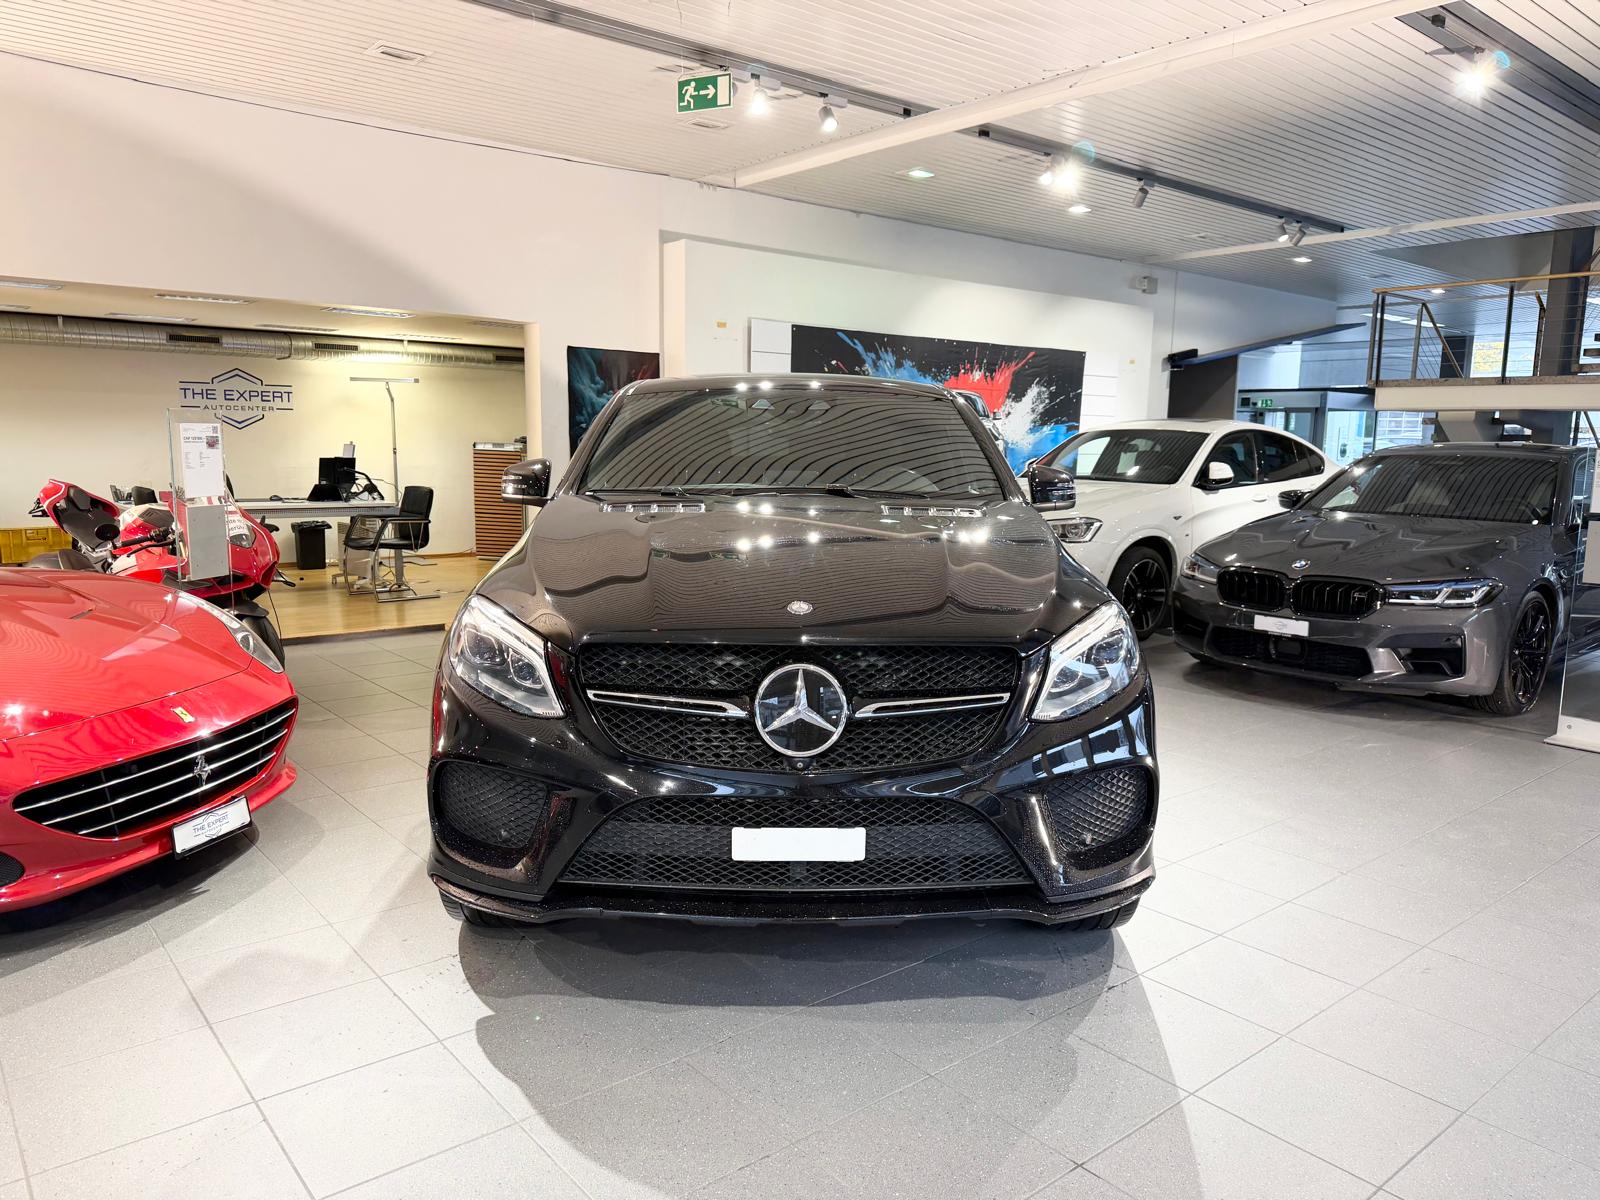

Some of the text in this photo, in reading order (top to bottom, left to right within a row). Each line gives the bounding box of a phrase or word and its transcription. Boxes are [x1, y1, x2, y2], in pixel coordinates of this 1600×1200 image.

[179, 387, 293, 403] THE EXPERT
[203, 404, 275, 412] AUTOCENTER
[193, 824, 206, 834] THE
[207, 814, 229, 829] EXPERT
